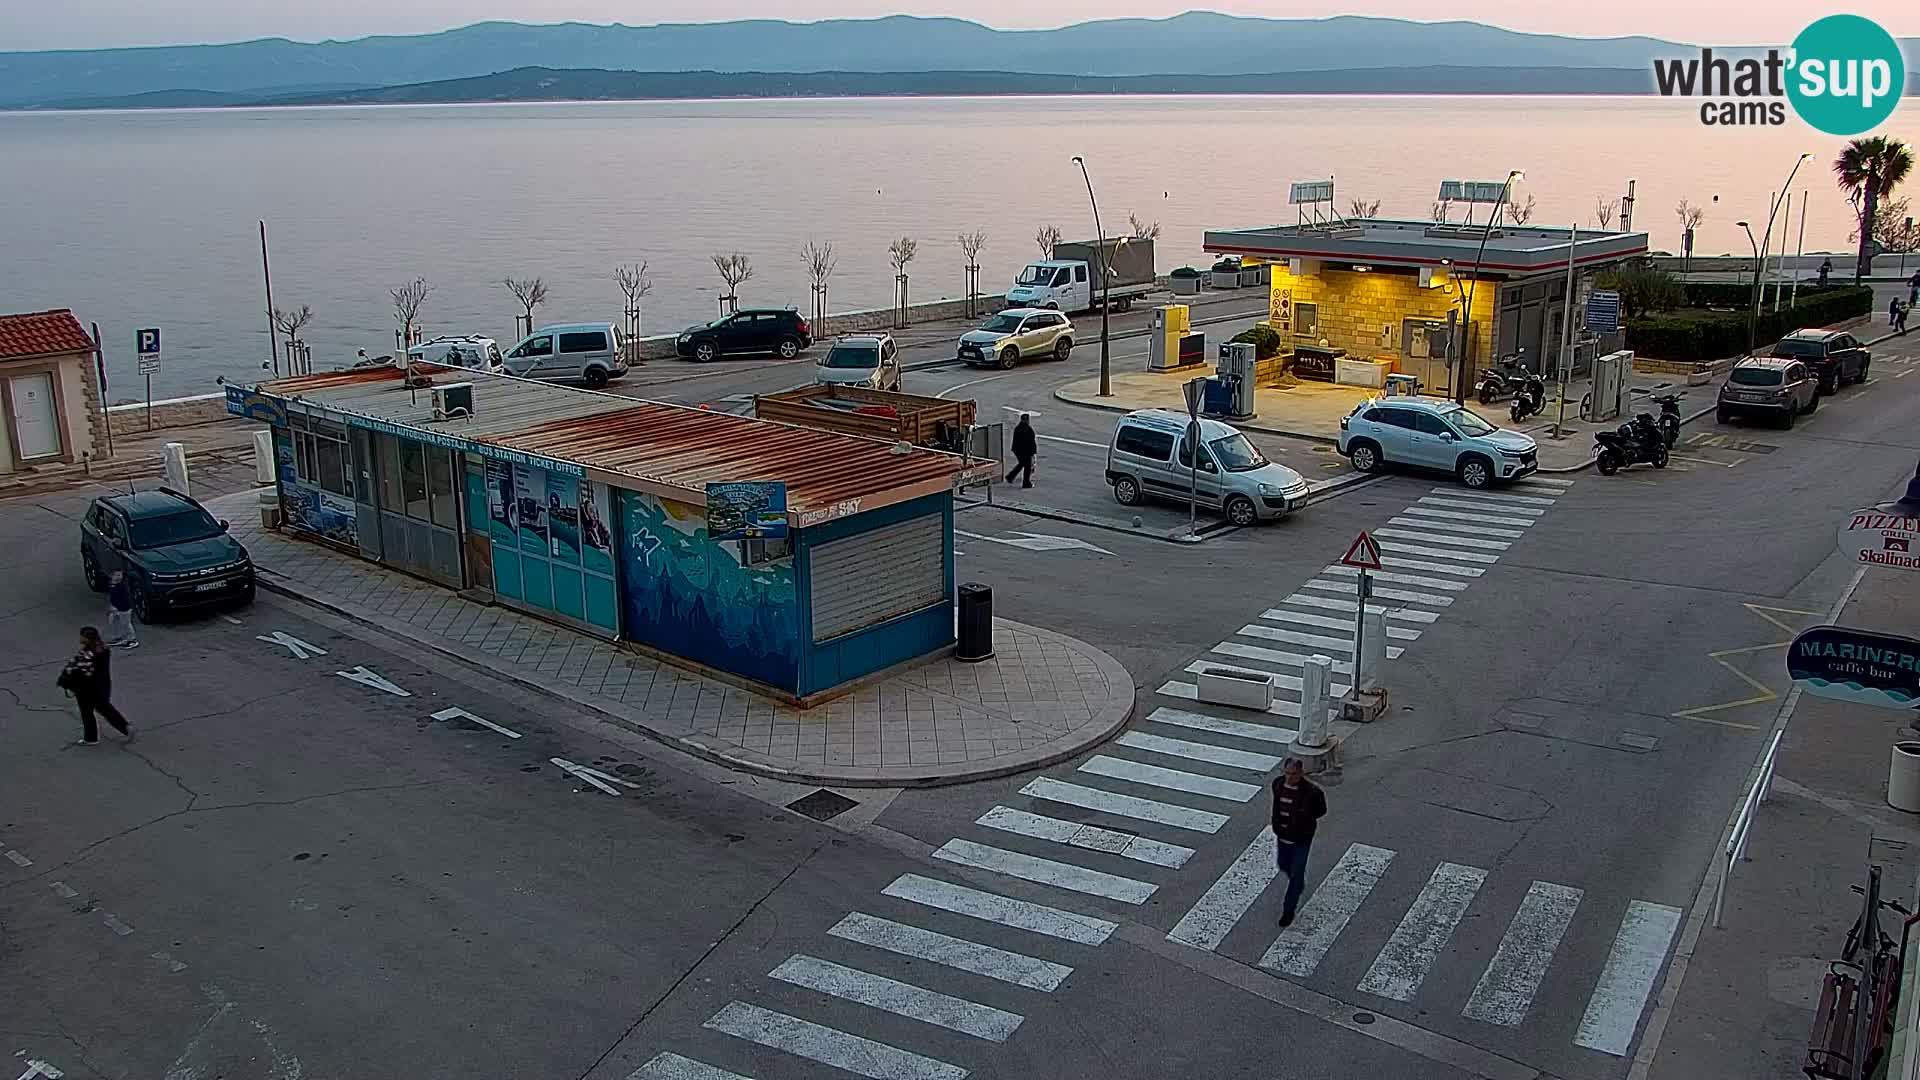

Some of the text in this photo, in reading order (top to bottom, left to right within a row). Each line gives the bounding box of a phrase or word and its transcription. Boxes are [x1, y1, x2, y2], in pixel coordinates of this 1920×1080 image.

[142, 331, 155, 349] P
[436, 436, 469, 452] POSTAJA
[478, 446, 494, 456] BUS
[494, 449, 527, 464] STATION
[529, 456, 555, 470] TICKET
[556, 461, 583, 476] OFFICE
[1847, 515, 1920, 533] PIZZE
[1880, 529, 1917, 540] GRILL
[1869, 664, 1896, 679] bar
